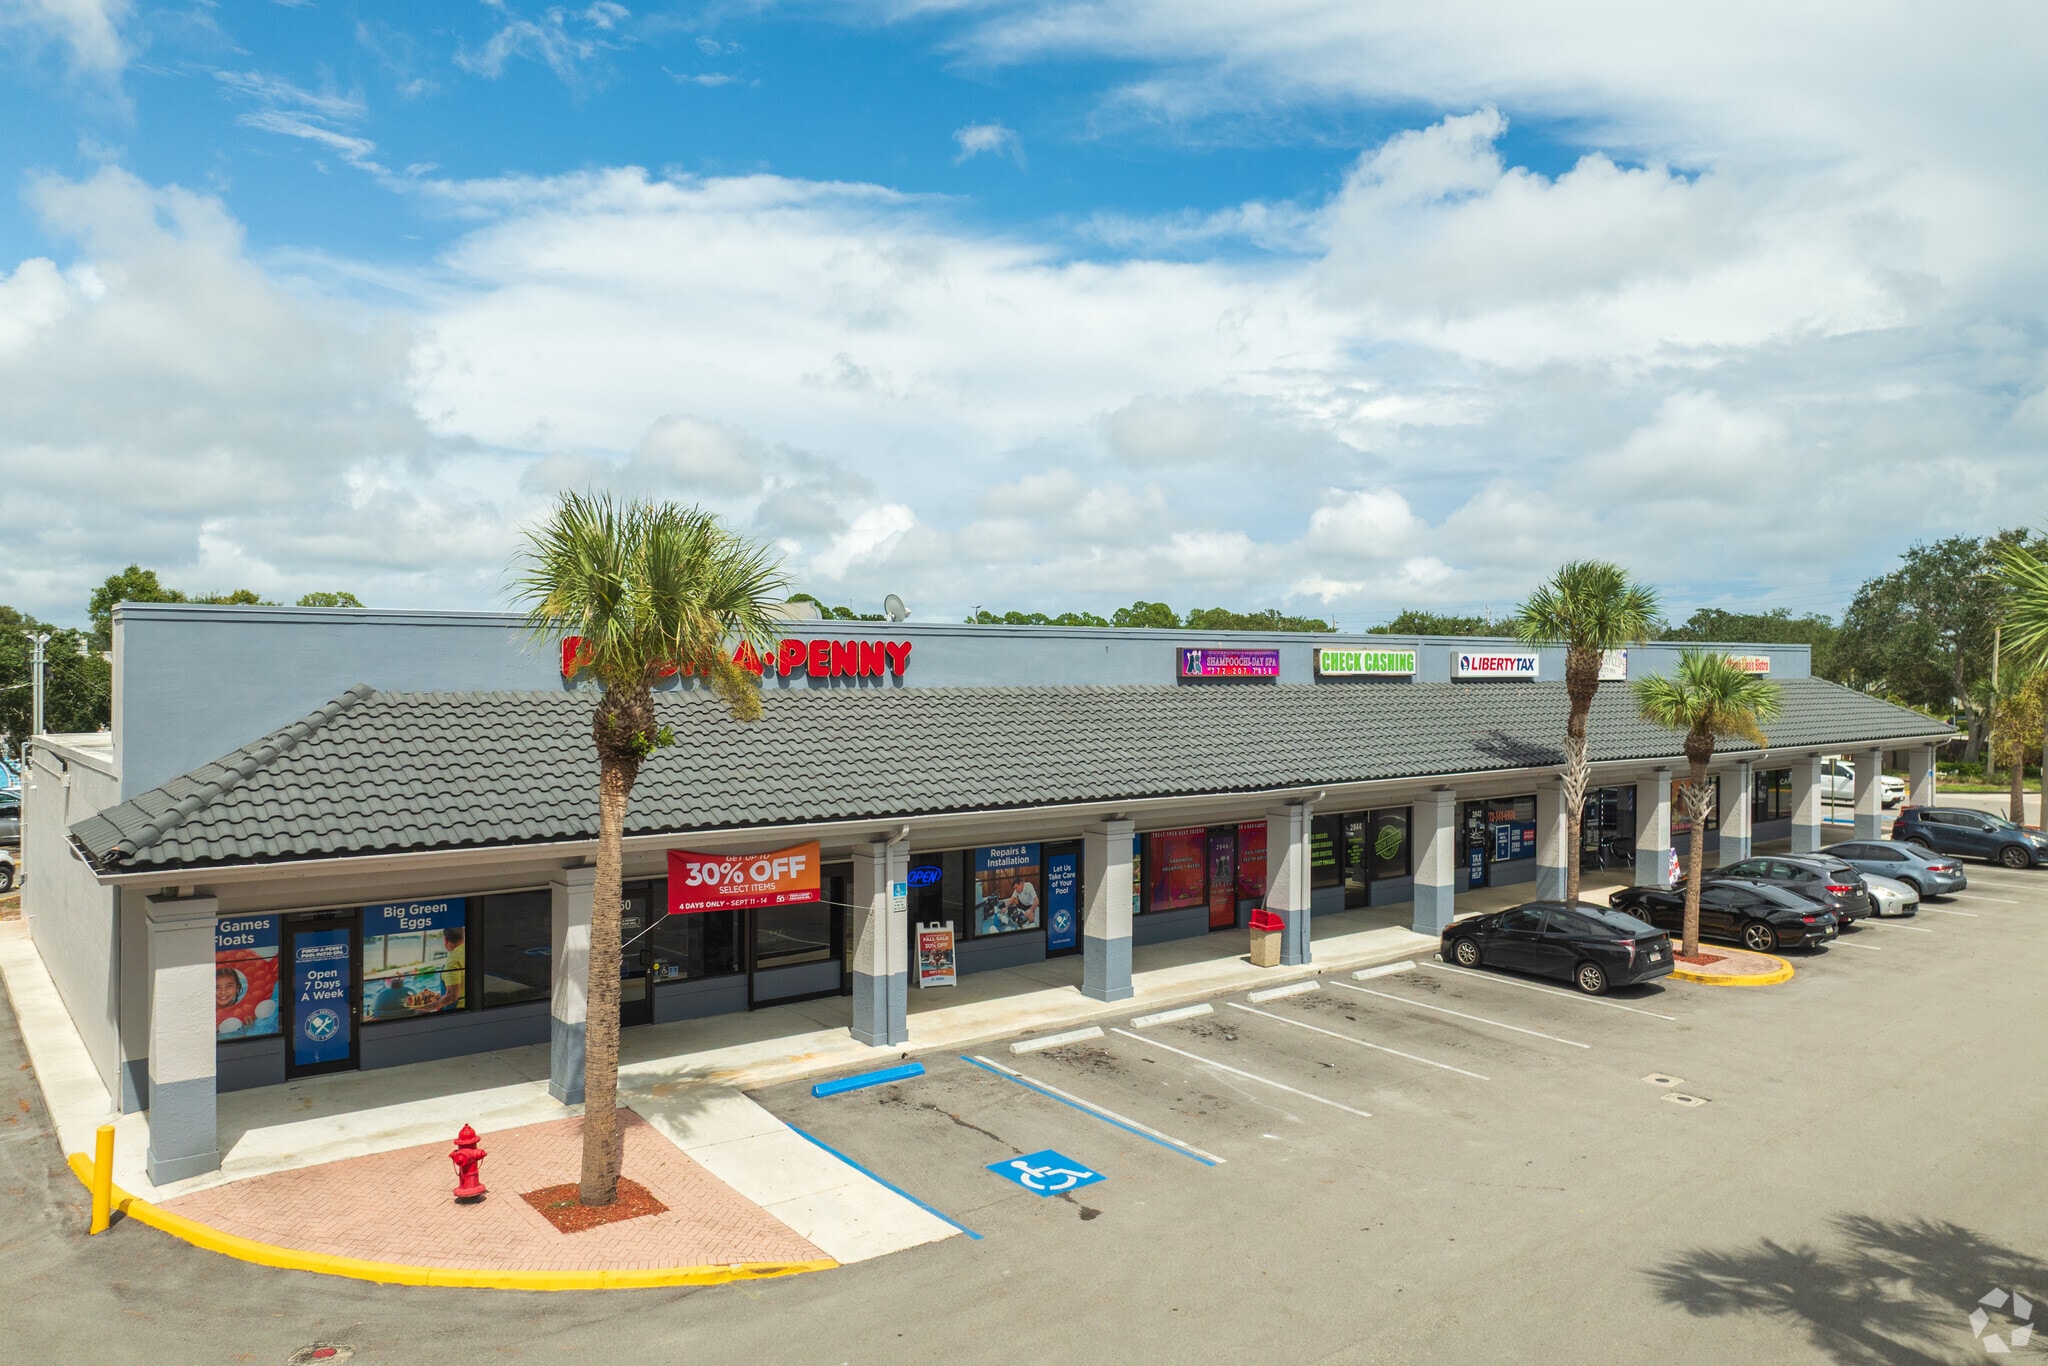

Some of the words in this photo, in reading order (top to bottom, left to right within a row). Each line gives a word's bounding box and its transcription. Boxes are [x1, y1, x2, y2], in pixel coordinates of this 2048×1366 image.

[1264, 657, 1277, 667] SPA
[1322, 652, 1362, 671] CHECK
[1364, 653, 1414, 672] CASHING
[1755, 658, 1769, 671] Bistro
[991, 847, 1019, 858] Repairs
[1021, 846, 1026, 854] &
[1472, 854, 1482, 862] TAX
[988, 856, 1029, 867] Installation
[685, 862, 744, 887] 30%
[749, 855, 806, 882] OFF
[907, 870, 938, 883] OPEN
[719, 884, 749, 894] SELECT
[751, 882, 776, 891] ITEMS
[706, 900, 725, 908] ONLY
[383, 906, 405, 918] Big
[409, 903, 448, 915] Green
[220, 920, 270, 932] Games
[400, 917, 432, 930] Eggs
[307, 970, 338, 980] Open
[304, 981, 311, 990] 7
[314, 980, 341, 990] Days
[301, 992, 310, 1001] A
[313, 989, 344, 1000] Week
